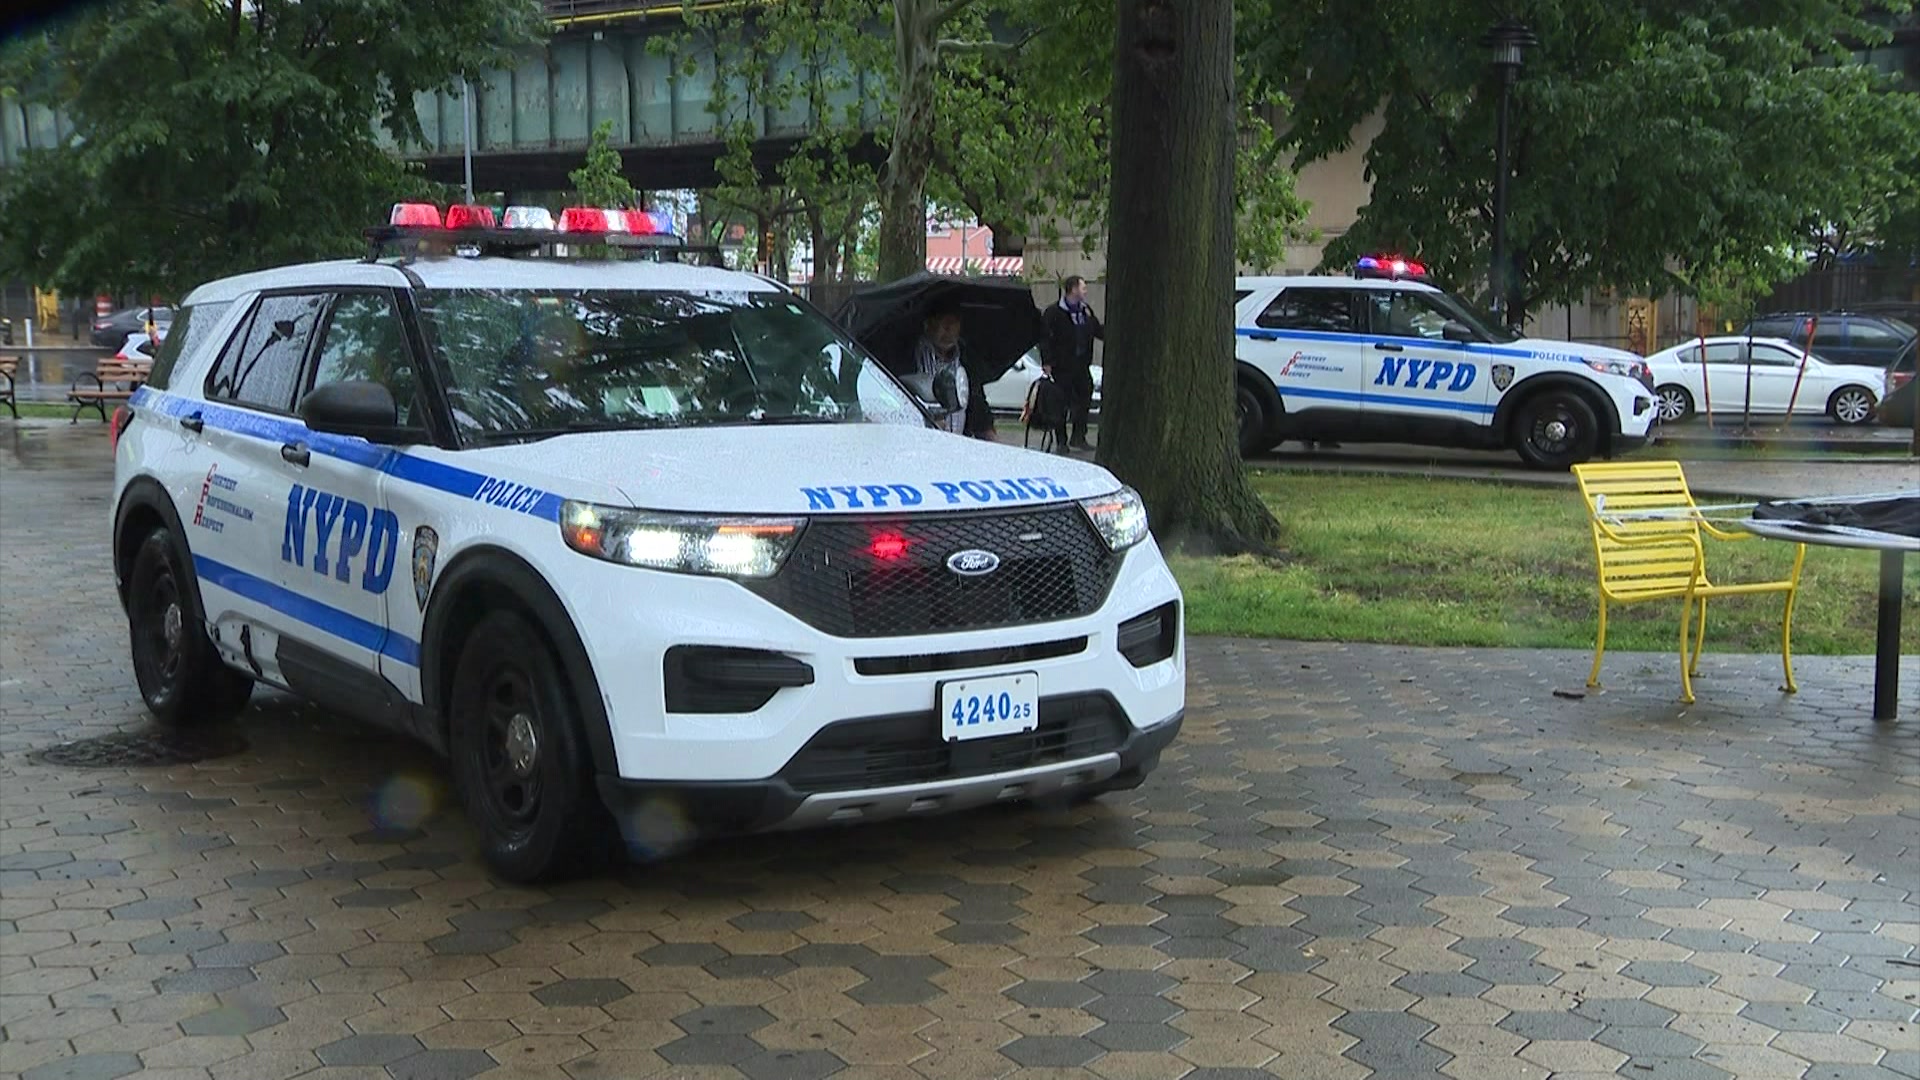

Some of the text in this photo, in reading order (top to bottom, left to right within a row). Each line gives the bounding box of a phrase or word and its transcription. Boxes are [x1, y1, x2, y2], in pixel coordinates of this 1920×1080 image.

[1374, 356, 1477, 392] NYPD
[1532, 351, 1568, 362] POLICE
[474, 477, 543, 514] POLICE
[800, 477, 1069, 510] NYPD POLICE
[281, 483, 399, 594] NYPD
[960, 554, 989, 570] Ford
[952, 691, 1031, 727] 4240 25
